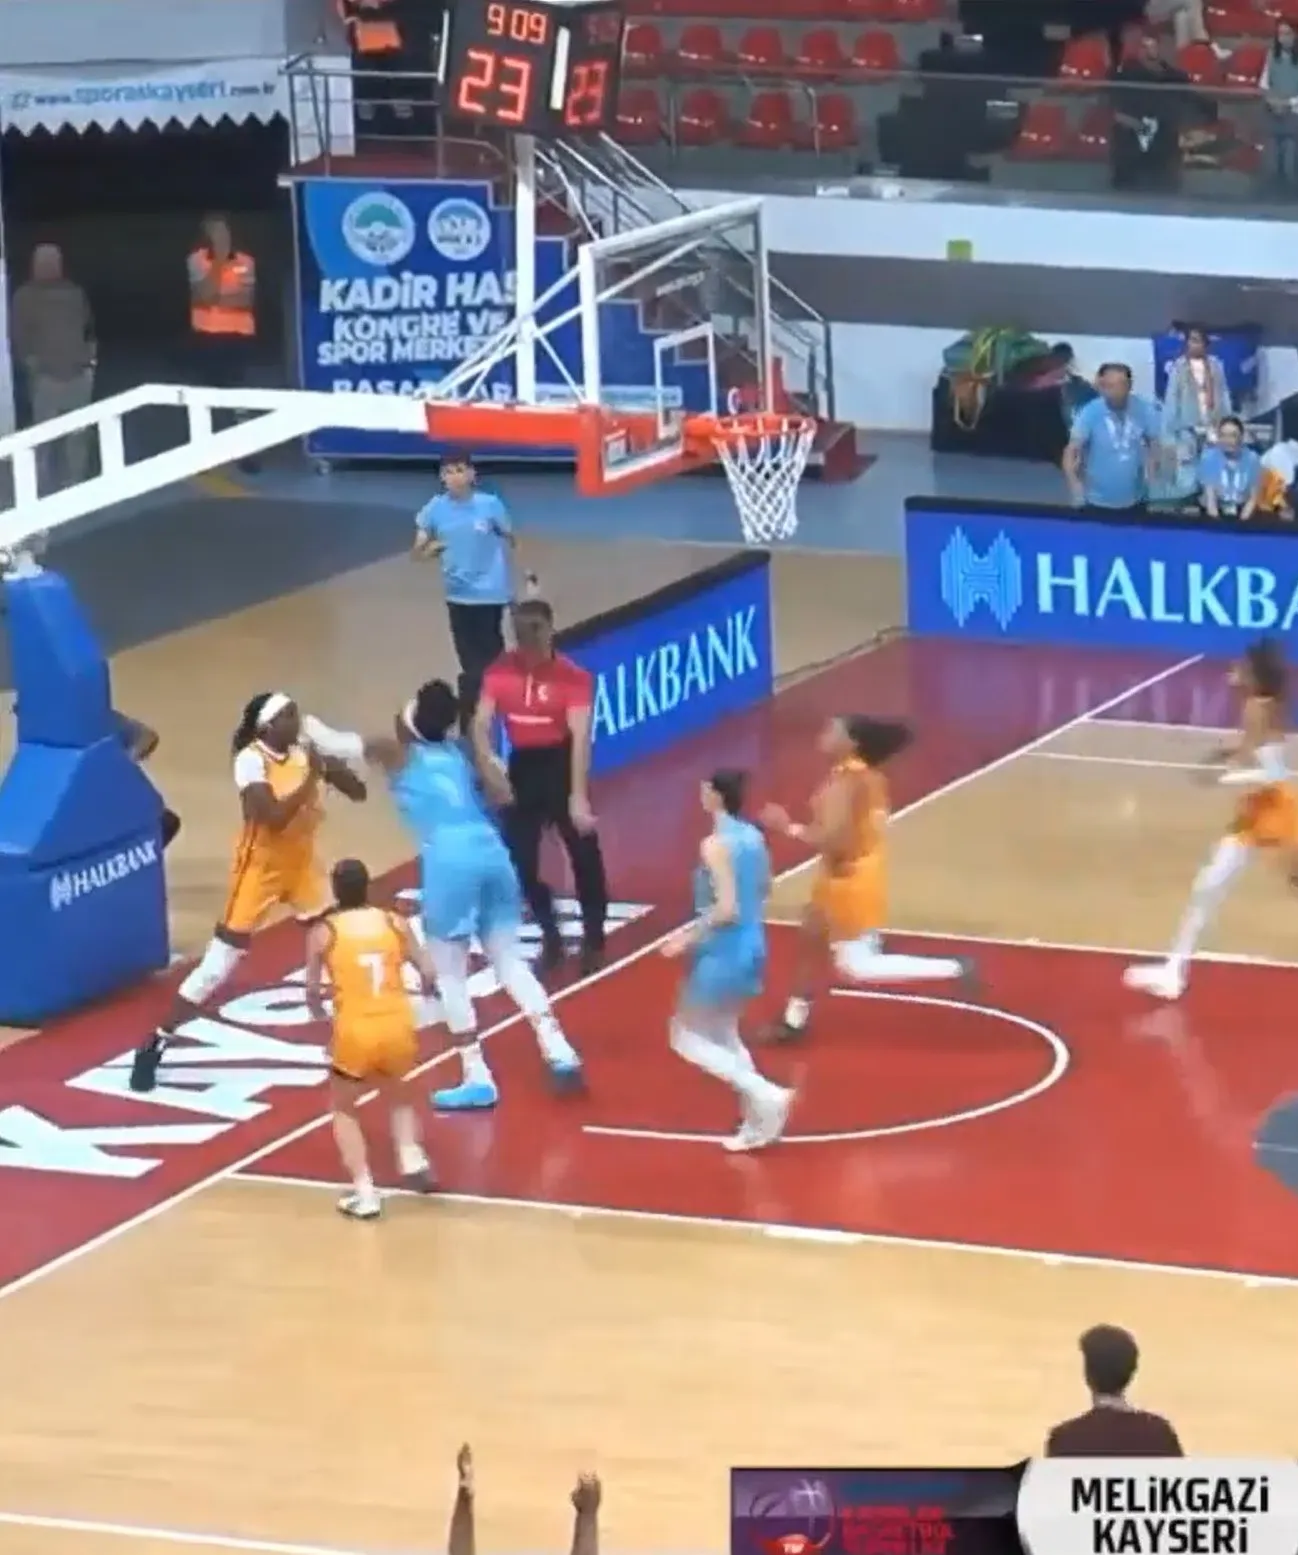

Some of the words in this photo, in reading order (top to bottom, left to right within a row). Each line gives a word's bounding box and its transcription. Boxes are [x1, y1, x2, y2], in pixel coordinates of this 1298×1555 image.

[458, 48, 532, 123] 23
[317, 341, 388, 366] SPOR
[333, 311, 460, 341] KONGRE
[590, 603, 759, 744] ALKBANK
[73, 838, 158, 898] HALKBANK
